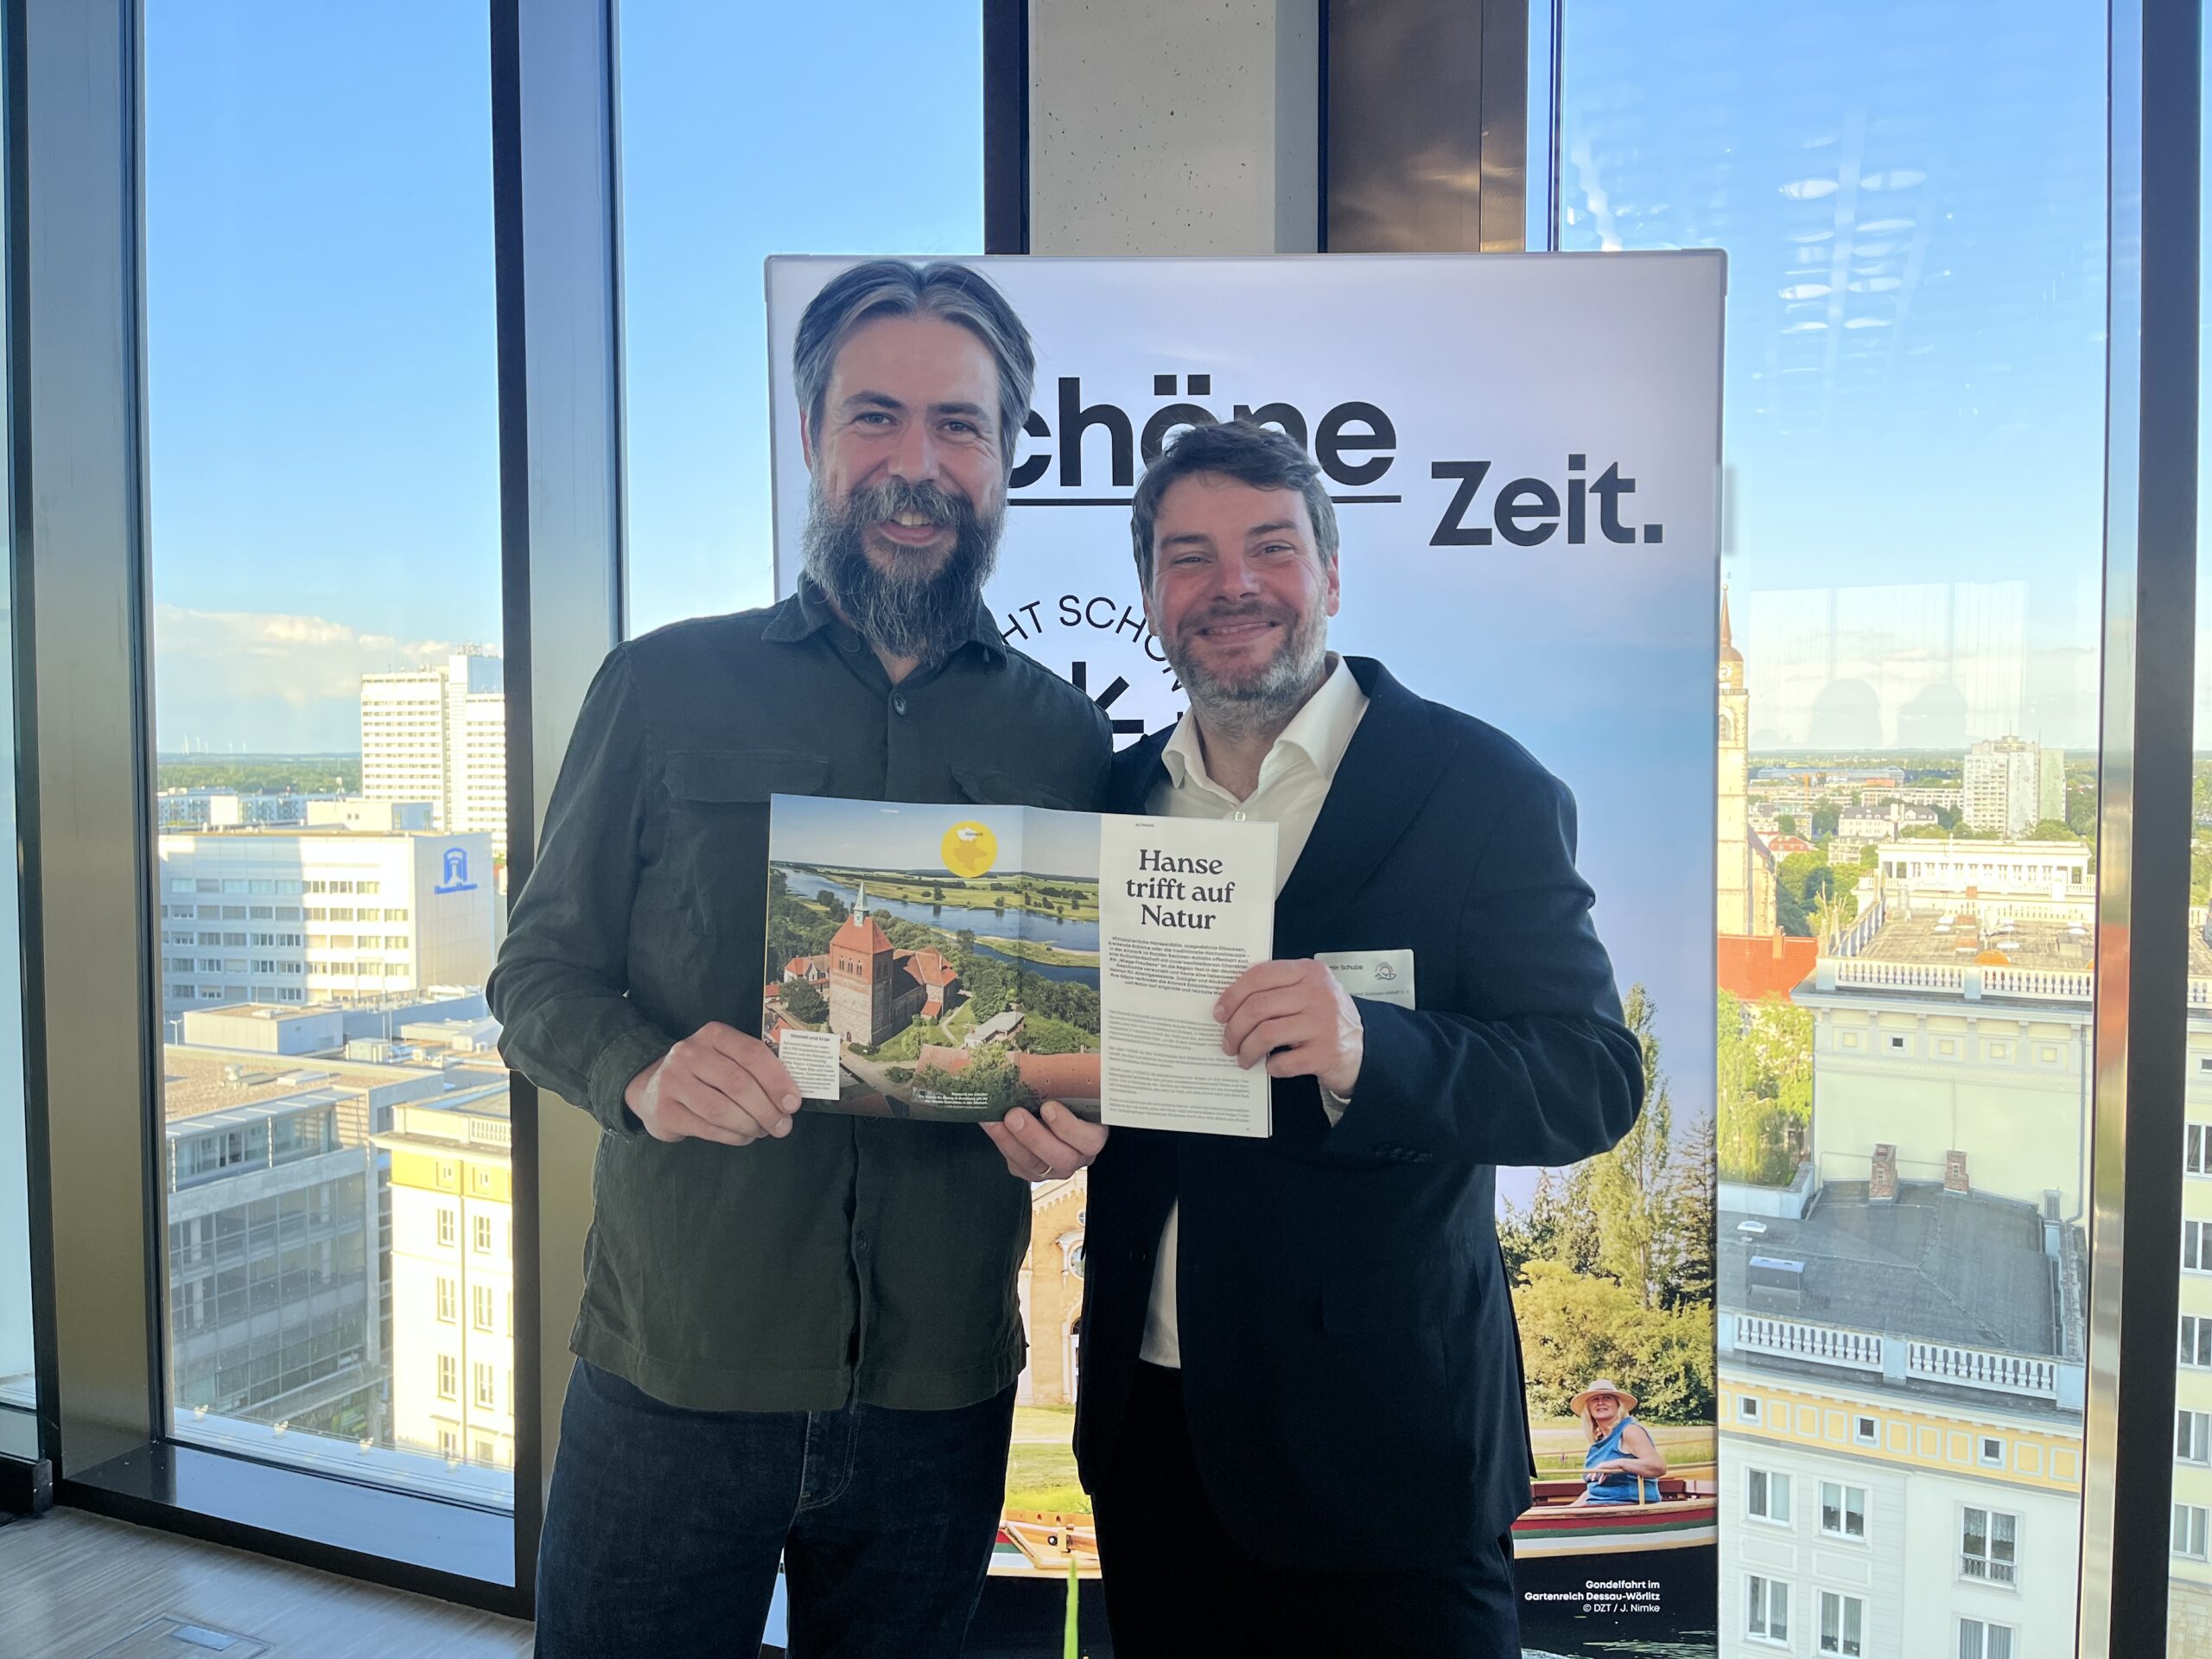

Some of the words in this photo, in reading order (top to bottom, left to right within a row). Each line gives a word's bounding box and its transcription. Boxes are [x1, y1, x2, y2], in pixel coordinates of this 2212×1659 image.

[1008, 375, 1397, 488] chöne
[1429, 454, 1663, 546] Zeit.
[1000, 601, 1042, 645] HT
[1139, 849, 1224, 874] Hanse
[1126, 877, 1186, 900] trifft
[1192, 881, 1236, 904] auf
[1141, 904, 1217, 930] Natur
[1524, 1592, 1584, 1601] Gartenreich
[1586, 1592, 1661, 1601] Dessau-Wörlitz
[1586, 1580, 1646, 1589] Gondelfahrt
[1648, 1580, 1660, 1589] im
[1593, 1604, 1611, 1612] DZT
[1619, 1604, 1629, 1612] J.
[1630, 1604, 1661, 1612] Nimke
